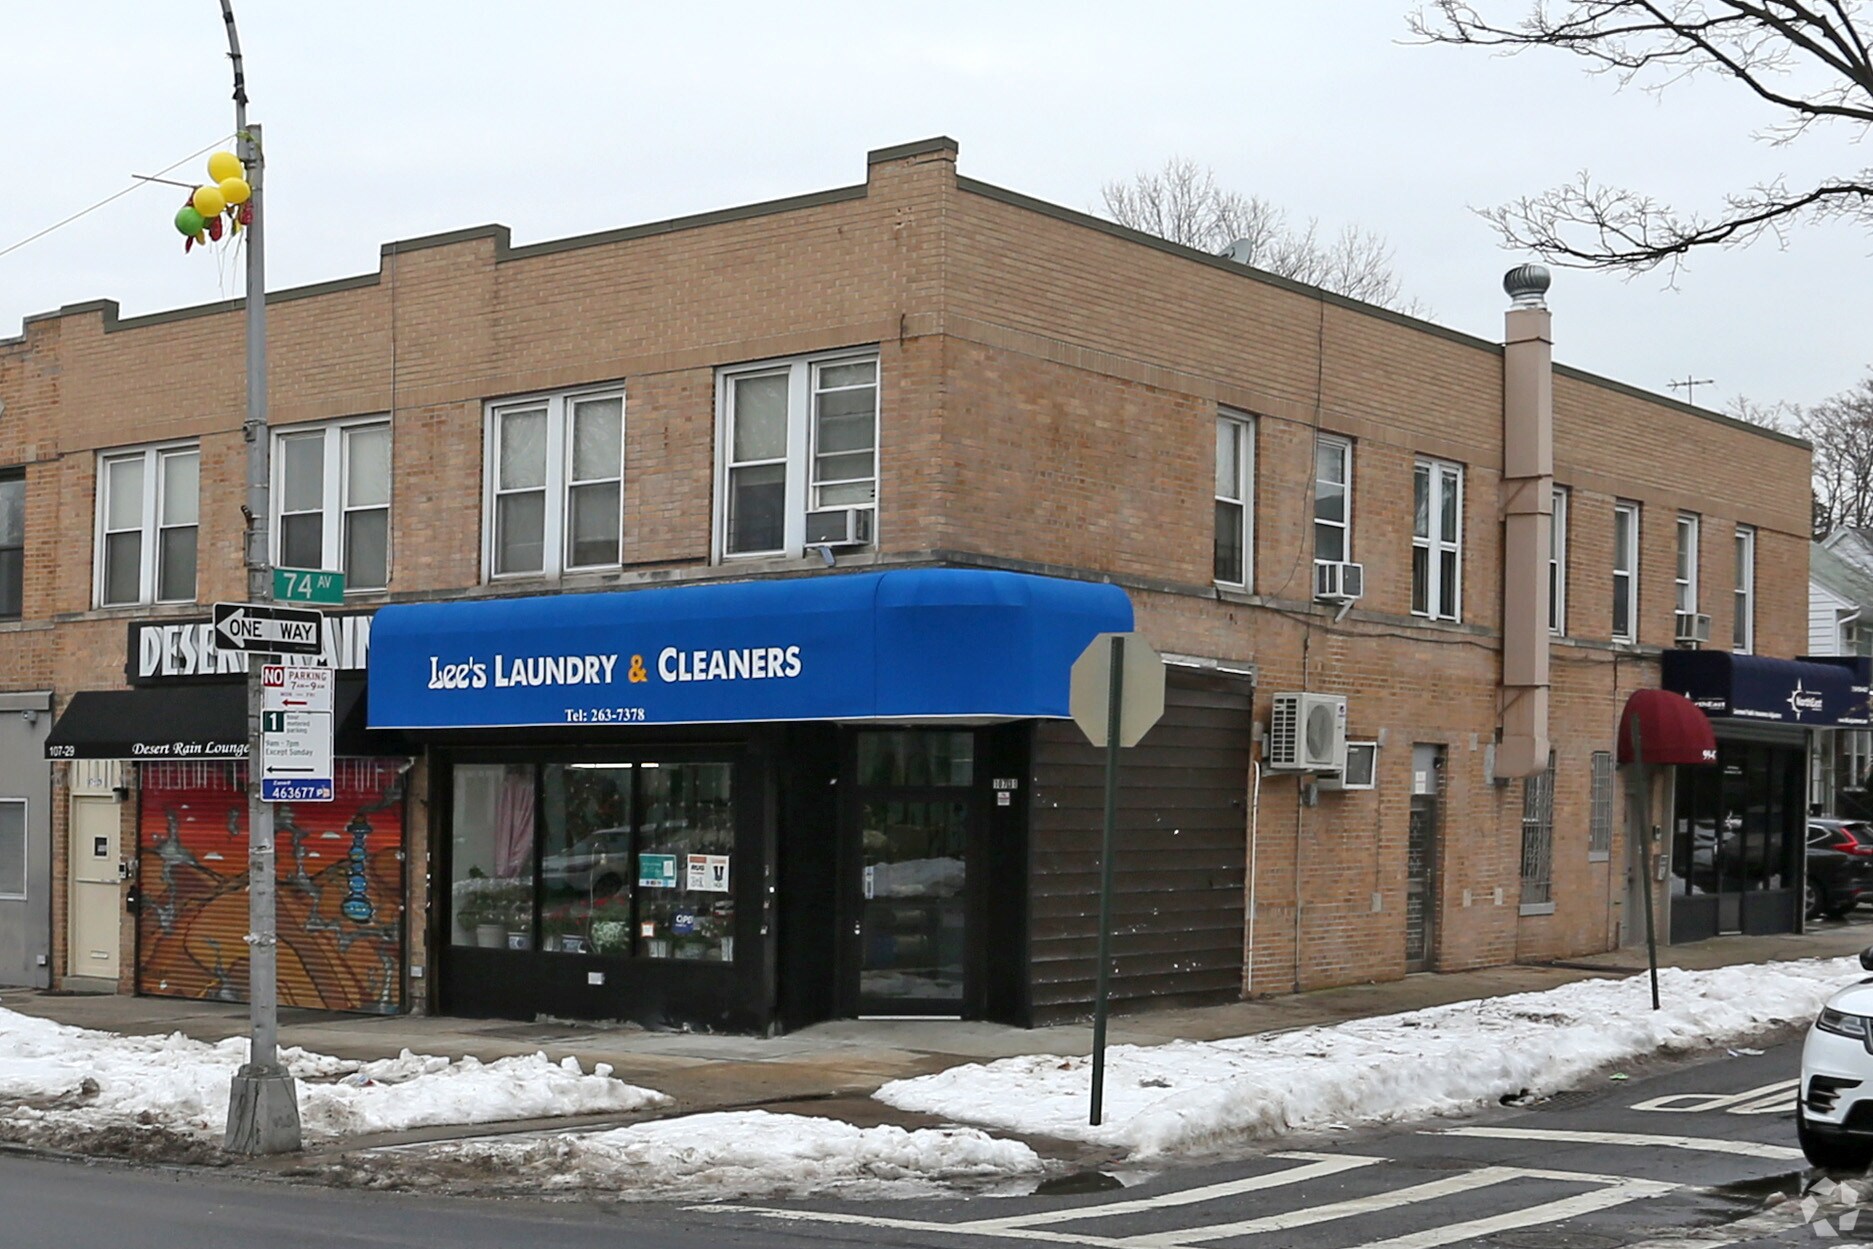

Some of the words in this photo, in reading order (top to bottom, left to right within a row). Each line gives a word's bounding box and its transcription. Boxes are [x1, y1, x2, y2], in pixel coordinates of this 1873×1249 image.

[283, 572, 313, 599] 74
[316, 575, 333, 588] AV
[229, 619, 262, 638] ONE
[280, 622, 313, 641] WAY
[428, 656, 487, 690] Lee's
[495, 654, 618, 688] LAUNDRY
[627, 654, 649, 684] &
[657, 646, 802, 683] CLEANERS
[264, 668, 283, 685] NO
[289, 671, 327, 682] PARKING
[269, 712, 277, 731] 1
[564, 708, 588, 722] Tel:
[591, 707, 645, 722] 263-7378
[49, 745, 75, 757] 107-29
[132, 743, 170, 755] Desert
[173, 741, 202, 756] Rain
[204, 741, 250, 757] Lounge
[289, 749, 314, 757] Sunday
[272, 786, 315, 799] 463677
